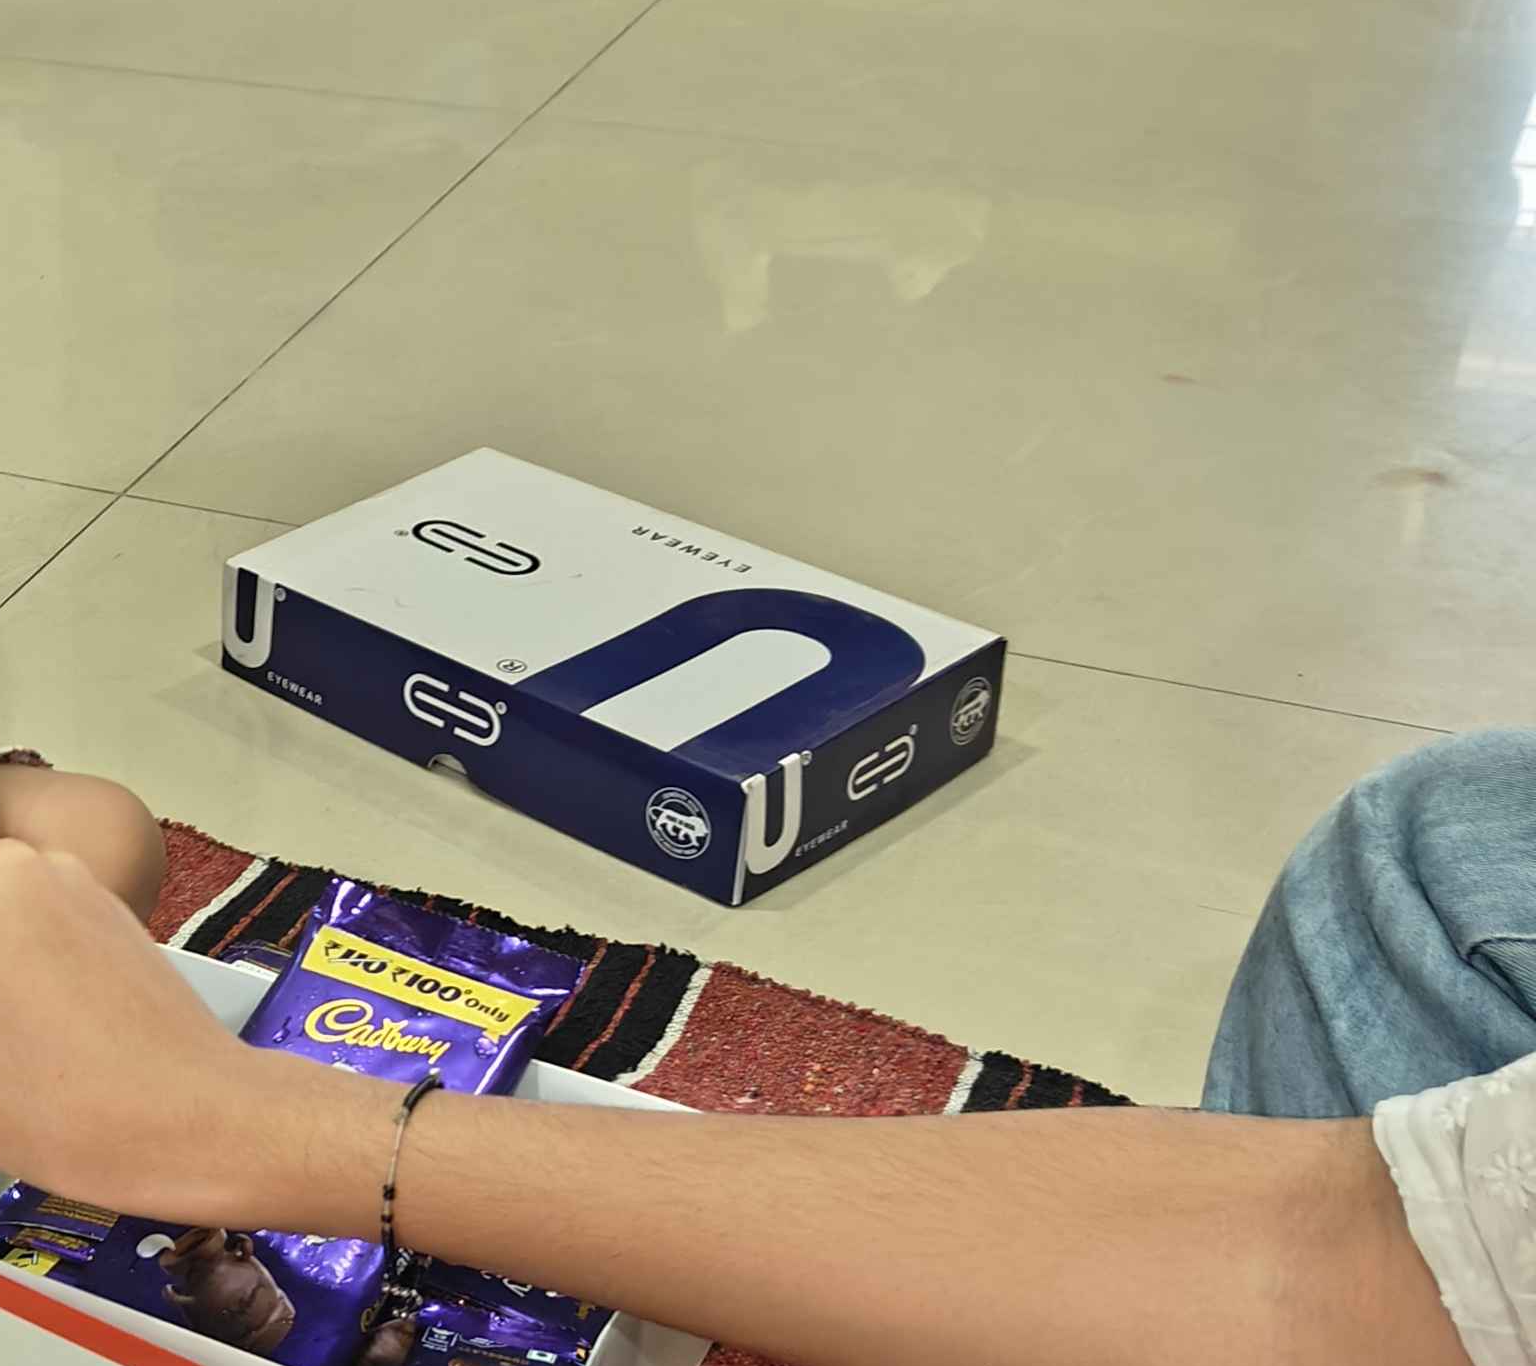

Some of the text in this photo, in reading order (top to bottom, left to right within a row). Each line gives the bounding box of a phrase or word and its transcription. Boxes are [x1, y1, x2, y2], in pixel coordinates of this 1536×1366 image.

[632, 525, 753, 574] EYEWEAR
[267, 671, 324, 706] EYEWEAR
[464, 996, 511, 1023] Only
[304, 998, 453, 1065] Cadbury
